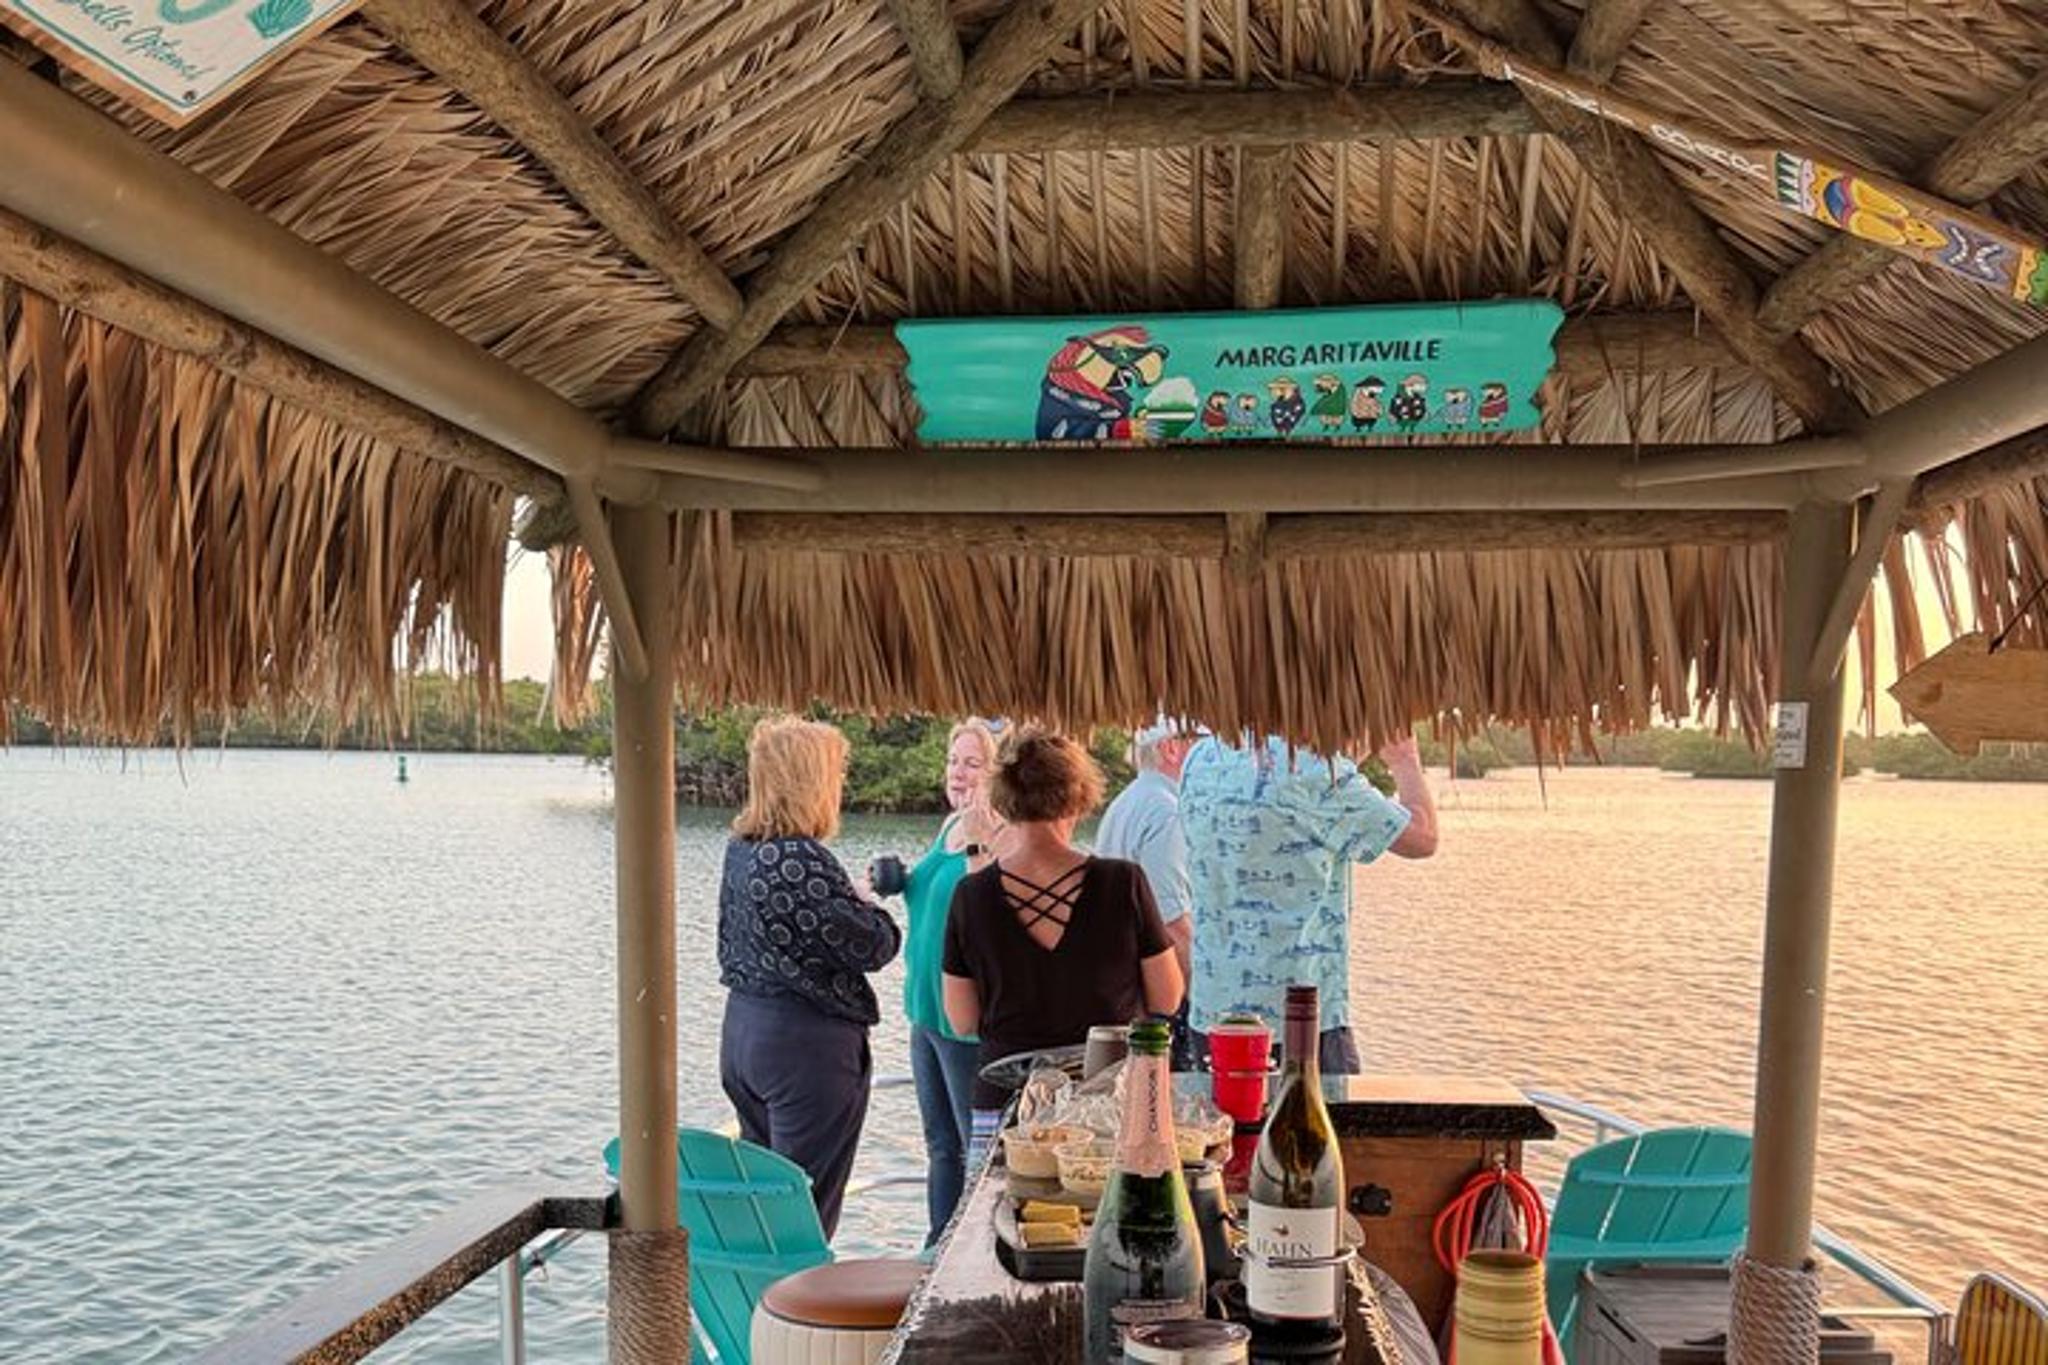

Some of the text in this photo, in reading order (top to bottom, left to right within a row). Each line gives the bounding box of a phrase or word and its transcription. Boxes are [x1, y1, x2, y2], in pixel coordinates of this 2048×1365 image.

[1215, 339, 1442, 368] MARGARITAVILLE
[1148, 1069, 1158, 1133] CHANDON
[1256, 1237, 1312, 1258] HAHN
